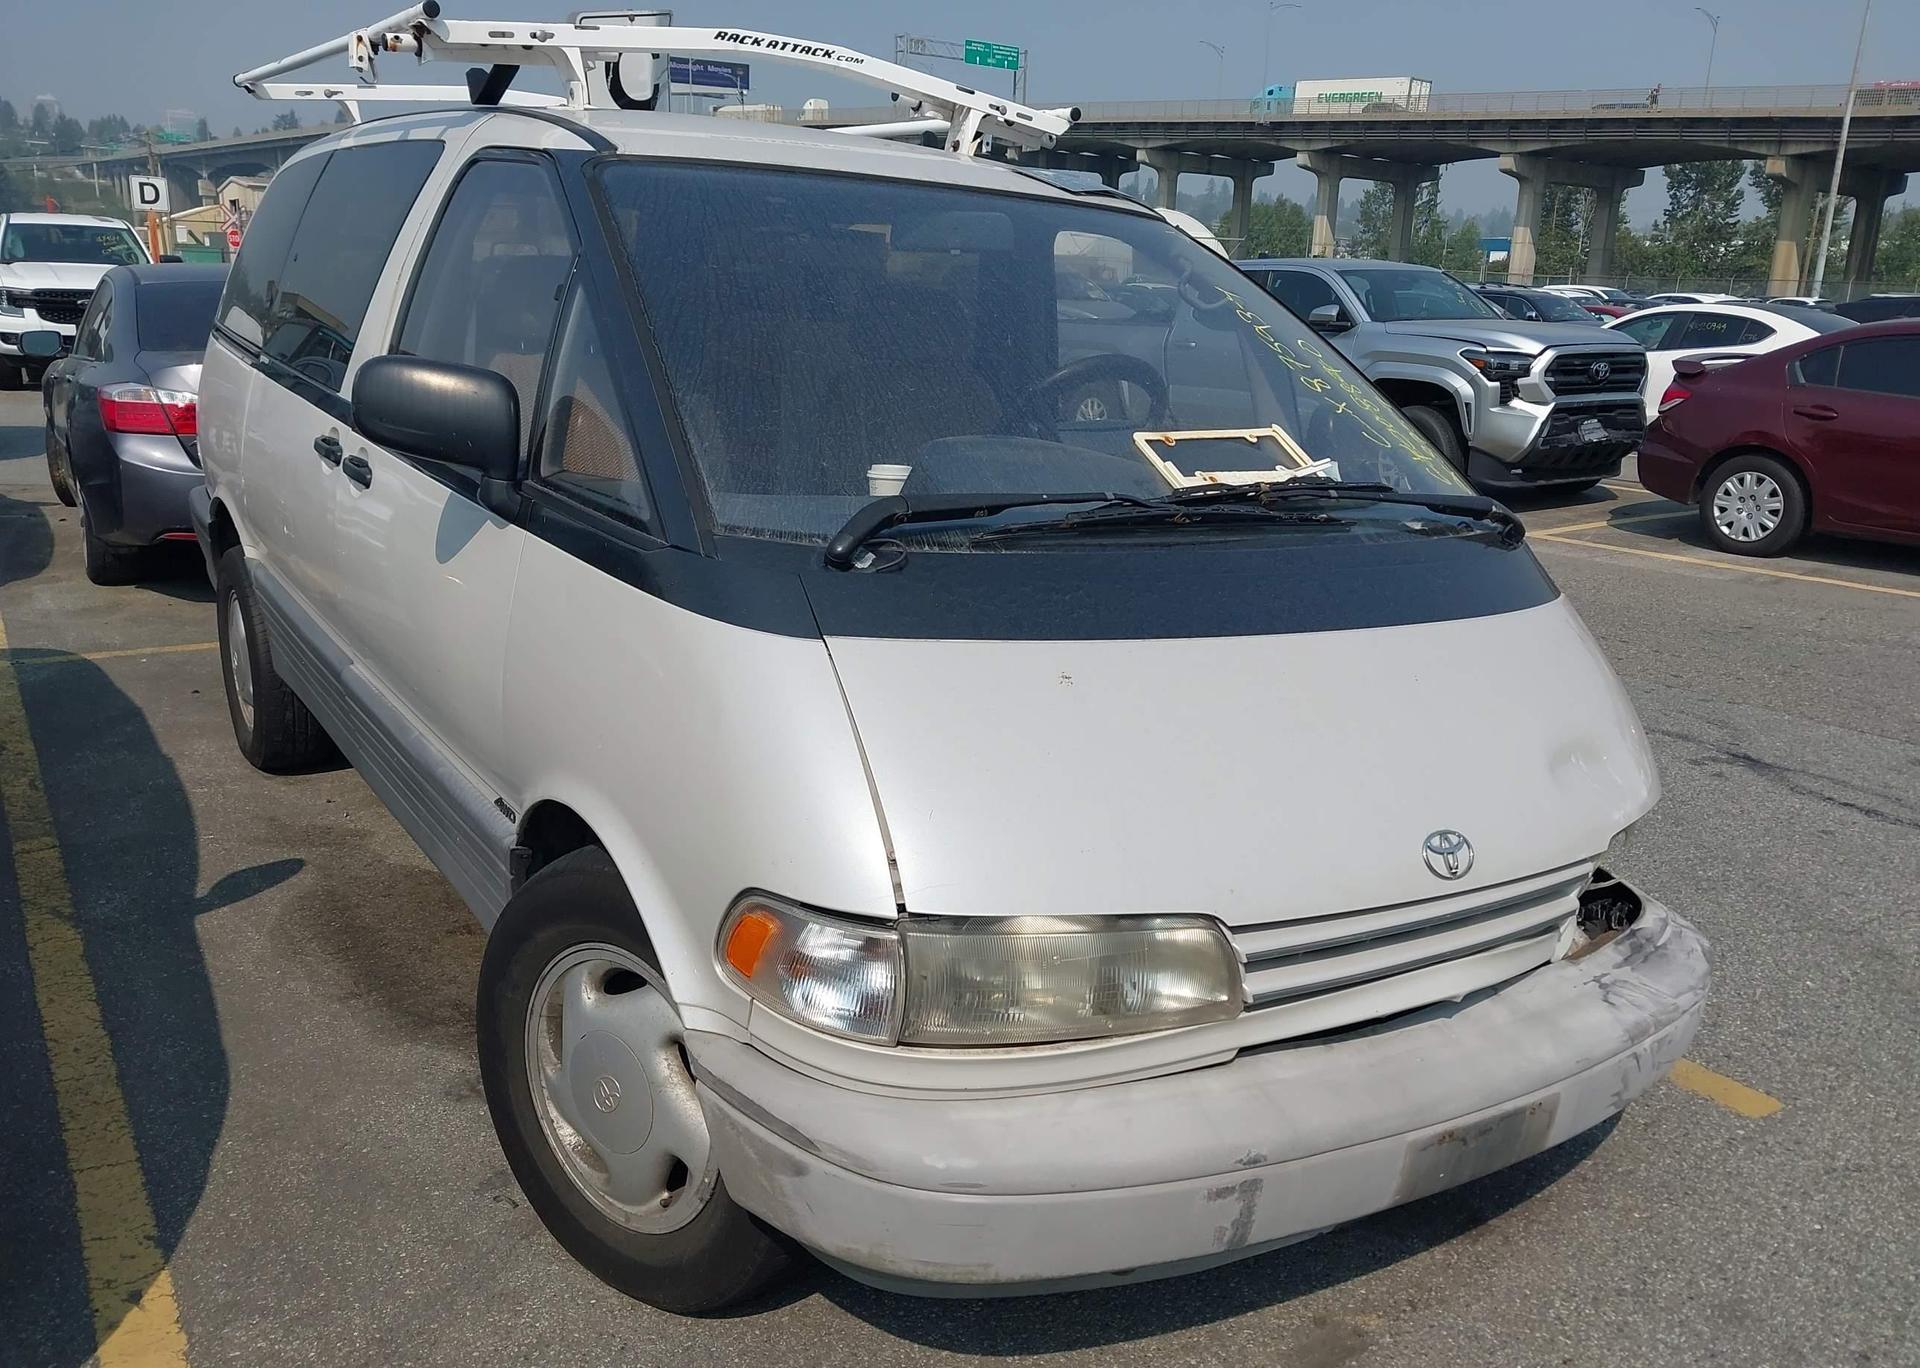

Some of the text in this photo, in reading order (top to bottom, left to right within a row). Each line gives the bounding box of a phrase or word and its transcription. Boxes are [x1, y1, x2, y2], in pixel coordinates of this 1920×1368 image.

[714, 31, 765, 47] RACK
[1317, 91, 1383, 104] EVERGREEN
[138, 182, 160, 205] D
[228, 234, 241, 243] STO
